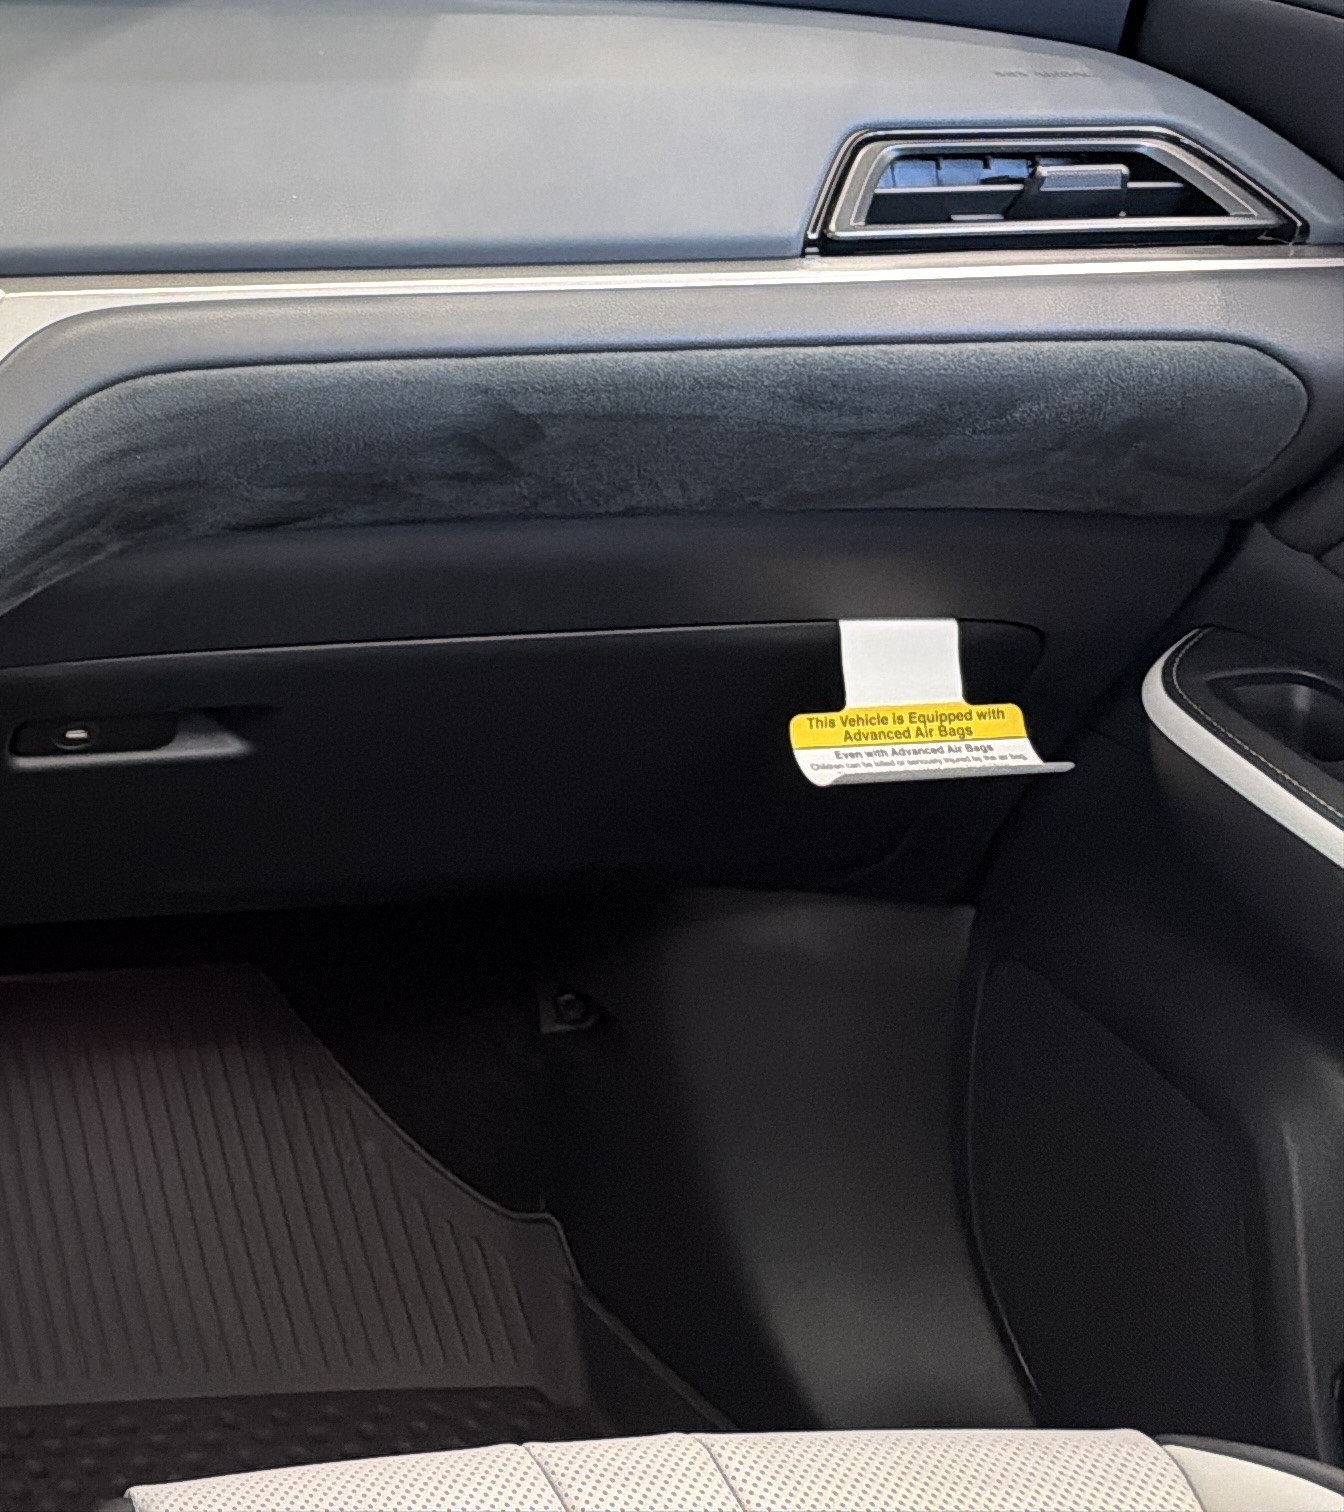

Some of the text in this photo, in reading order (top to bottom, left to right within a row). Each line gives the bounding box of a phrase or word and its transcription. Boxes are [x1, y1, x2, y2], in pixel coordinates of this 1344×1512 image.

[806, 716, 836, 730] This
[840, 714, 889, 728] Vehicle
[908, 710, 973, 729] Equipped
[976, 707, 1006, 721] with
[843, 724, 974, 743] Advanced Air Bags
[834, 743, 994, 760] Even with Advanced Air Bags
[810, 761, 844, 772] Children
